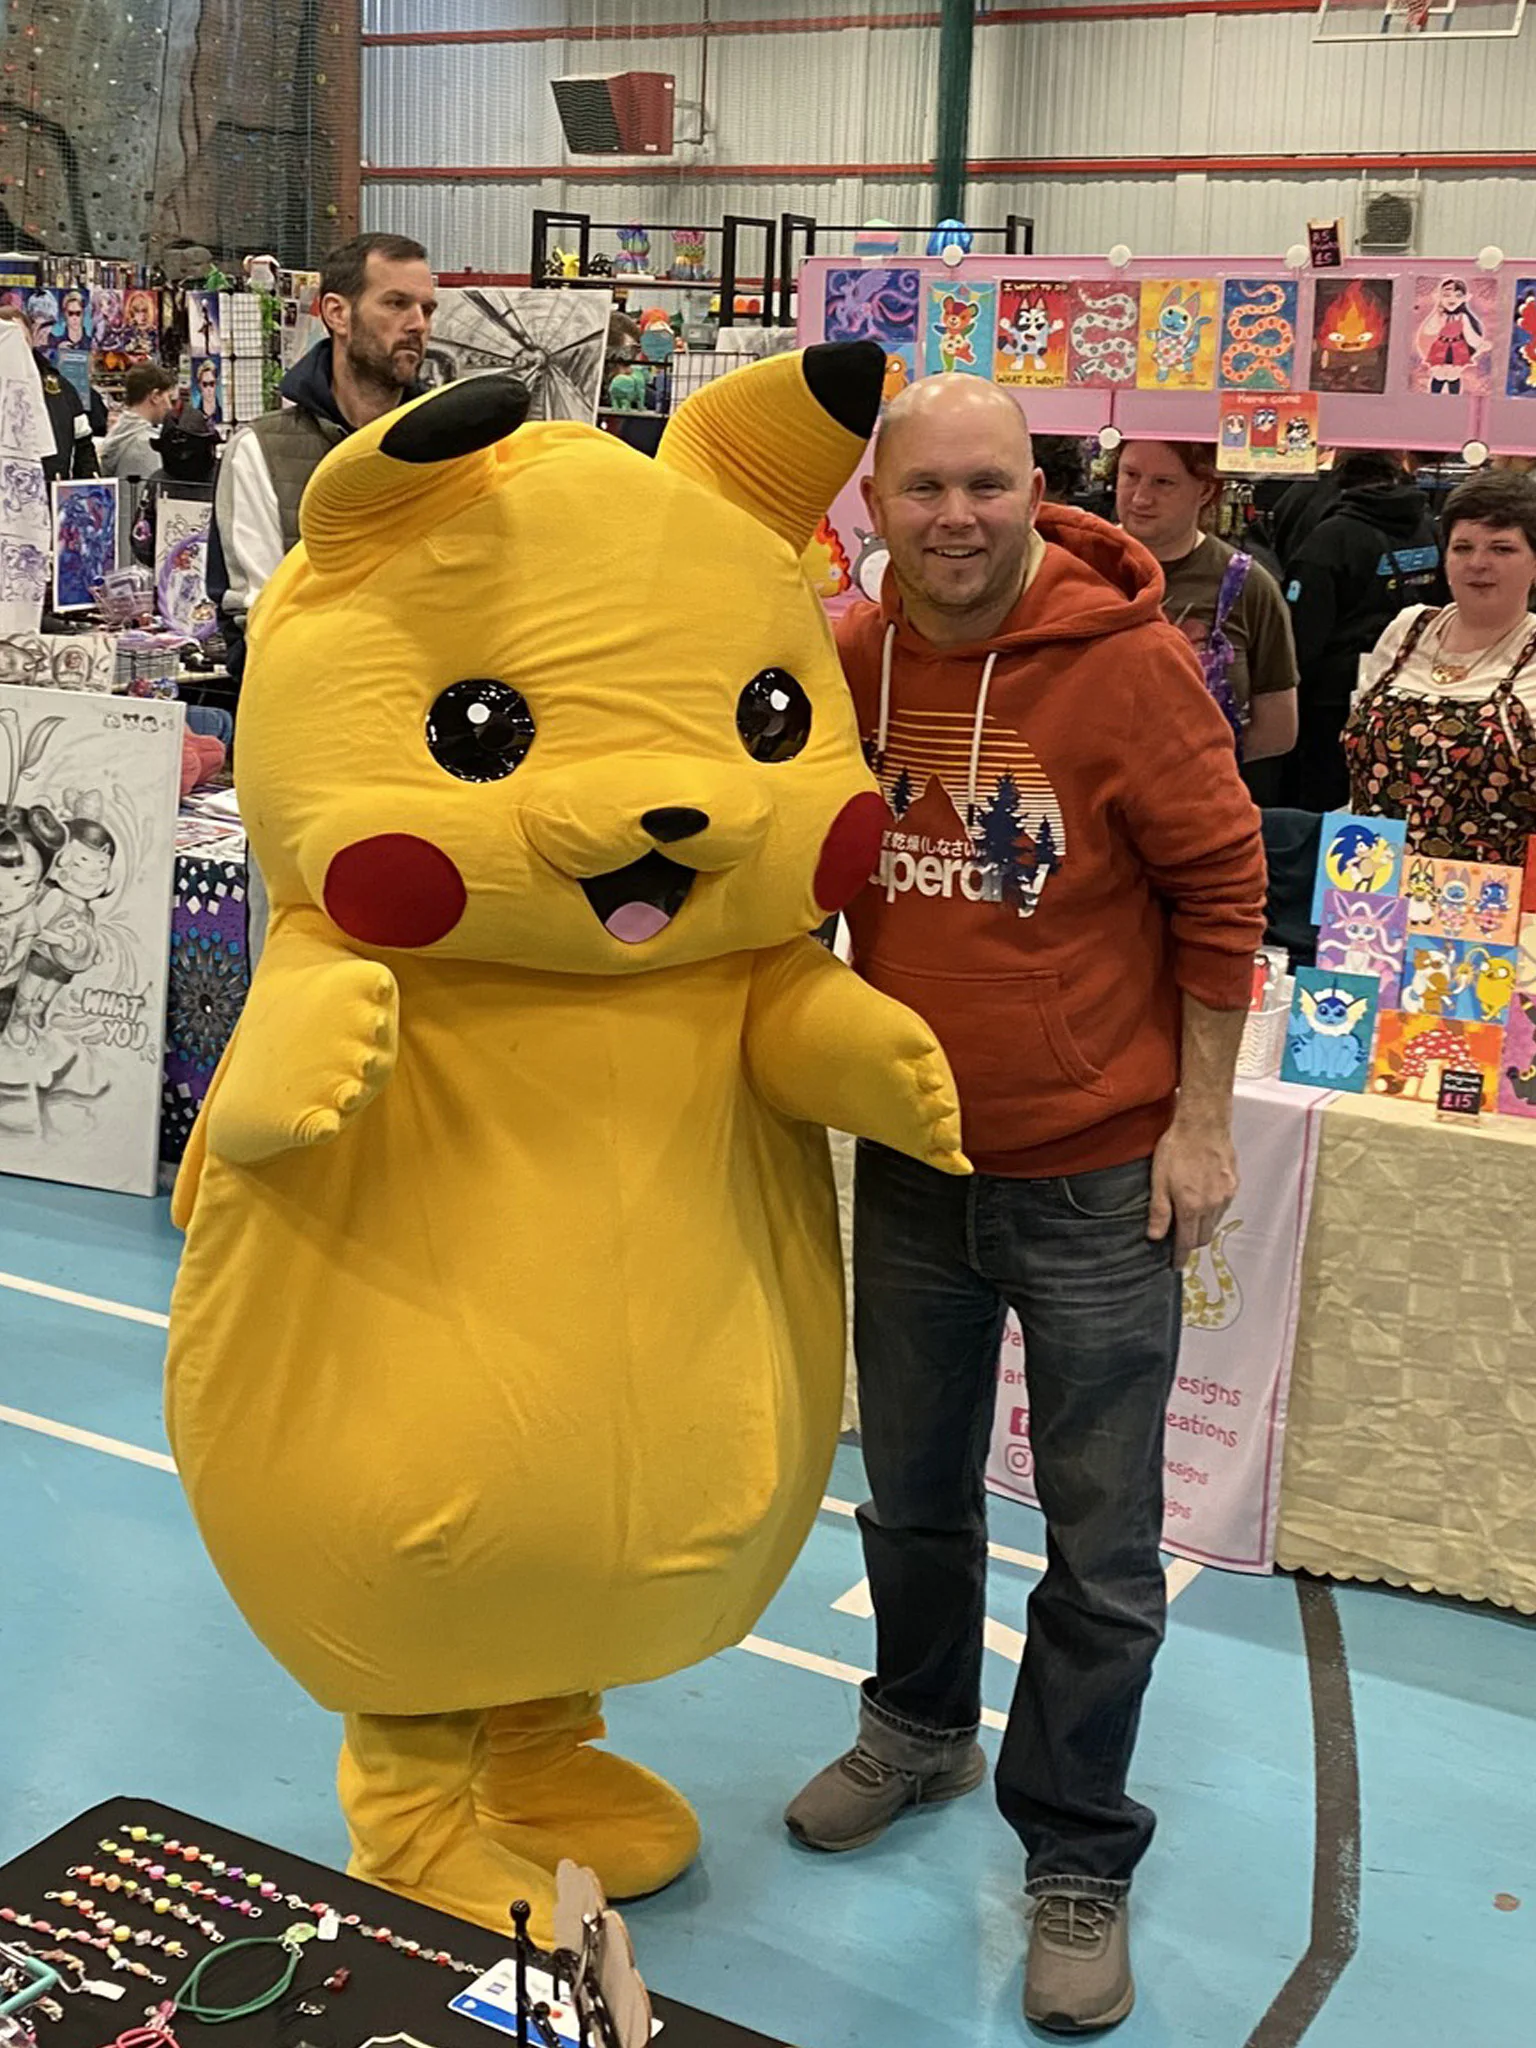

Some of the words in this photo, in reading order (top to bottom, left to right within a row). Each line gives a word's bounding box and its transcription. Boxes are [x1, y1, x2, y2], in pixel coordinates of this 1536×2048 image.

[1014, 283, 1038, 292] WANT
[1040, 283, 1053, 292] TO
[996, 374, 1023, 385] WHAT
[1026, 375, 1033, 385] I
[81, 987, 147, 1025] WHAT
[101, 1019, 149, 1052] YOU
[1442, 1093, 1475, 1108] £15
[1177, 1375, 1242, 1408] esigns
[1166, 1411, 1238, 1448] eations
[1167, 1460, 1209, 1485] esigns
